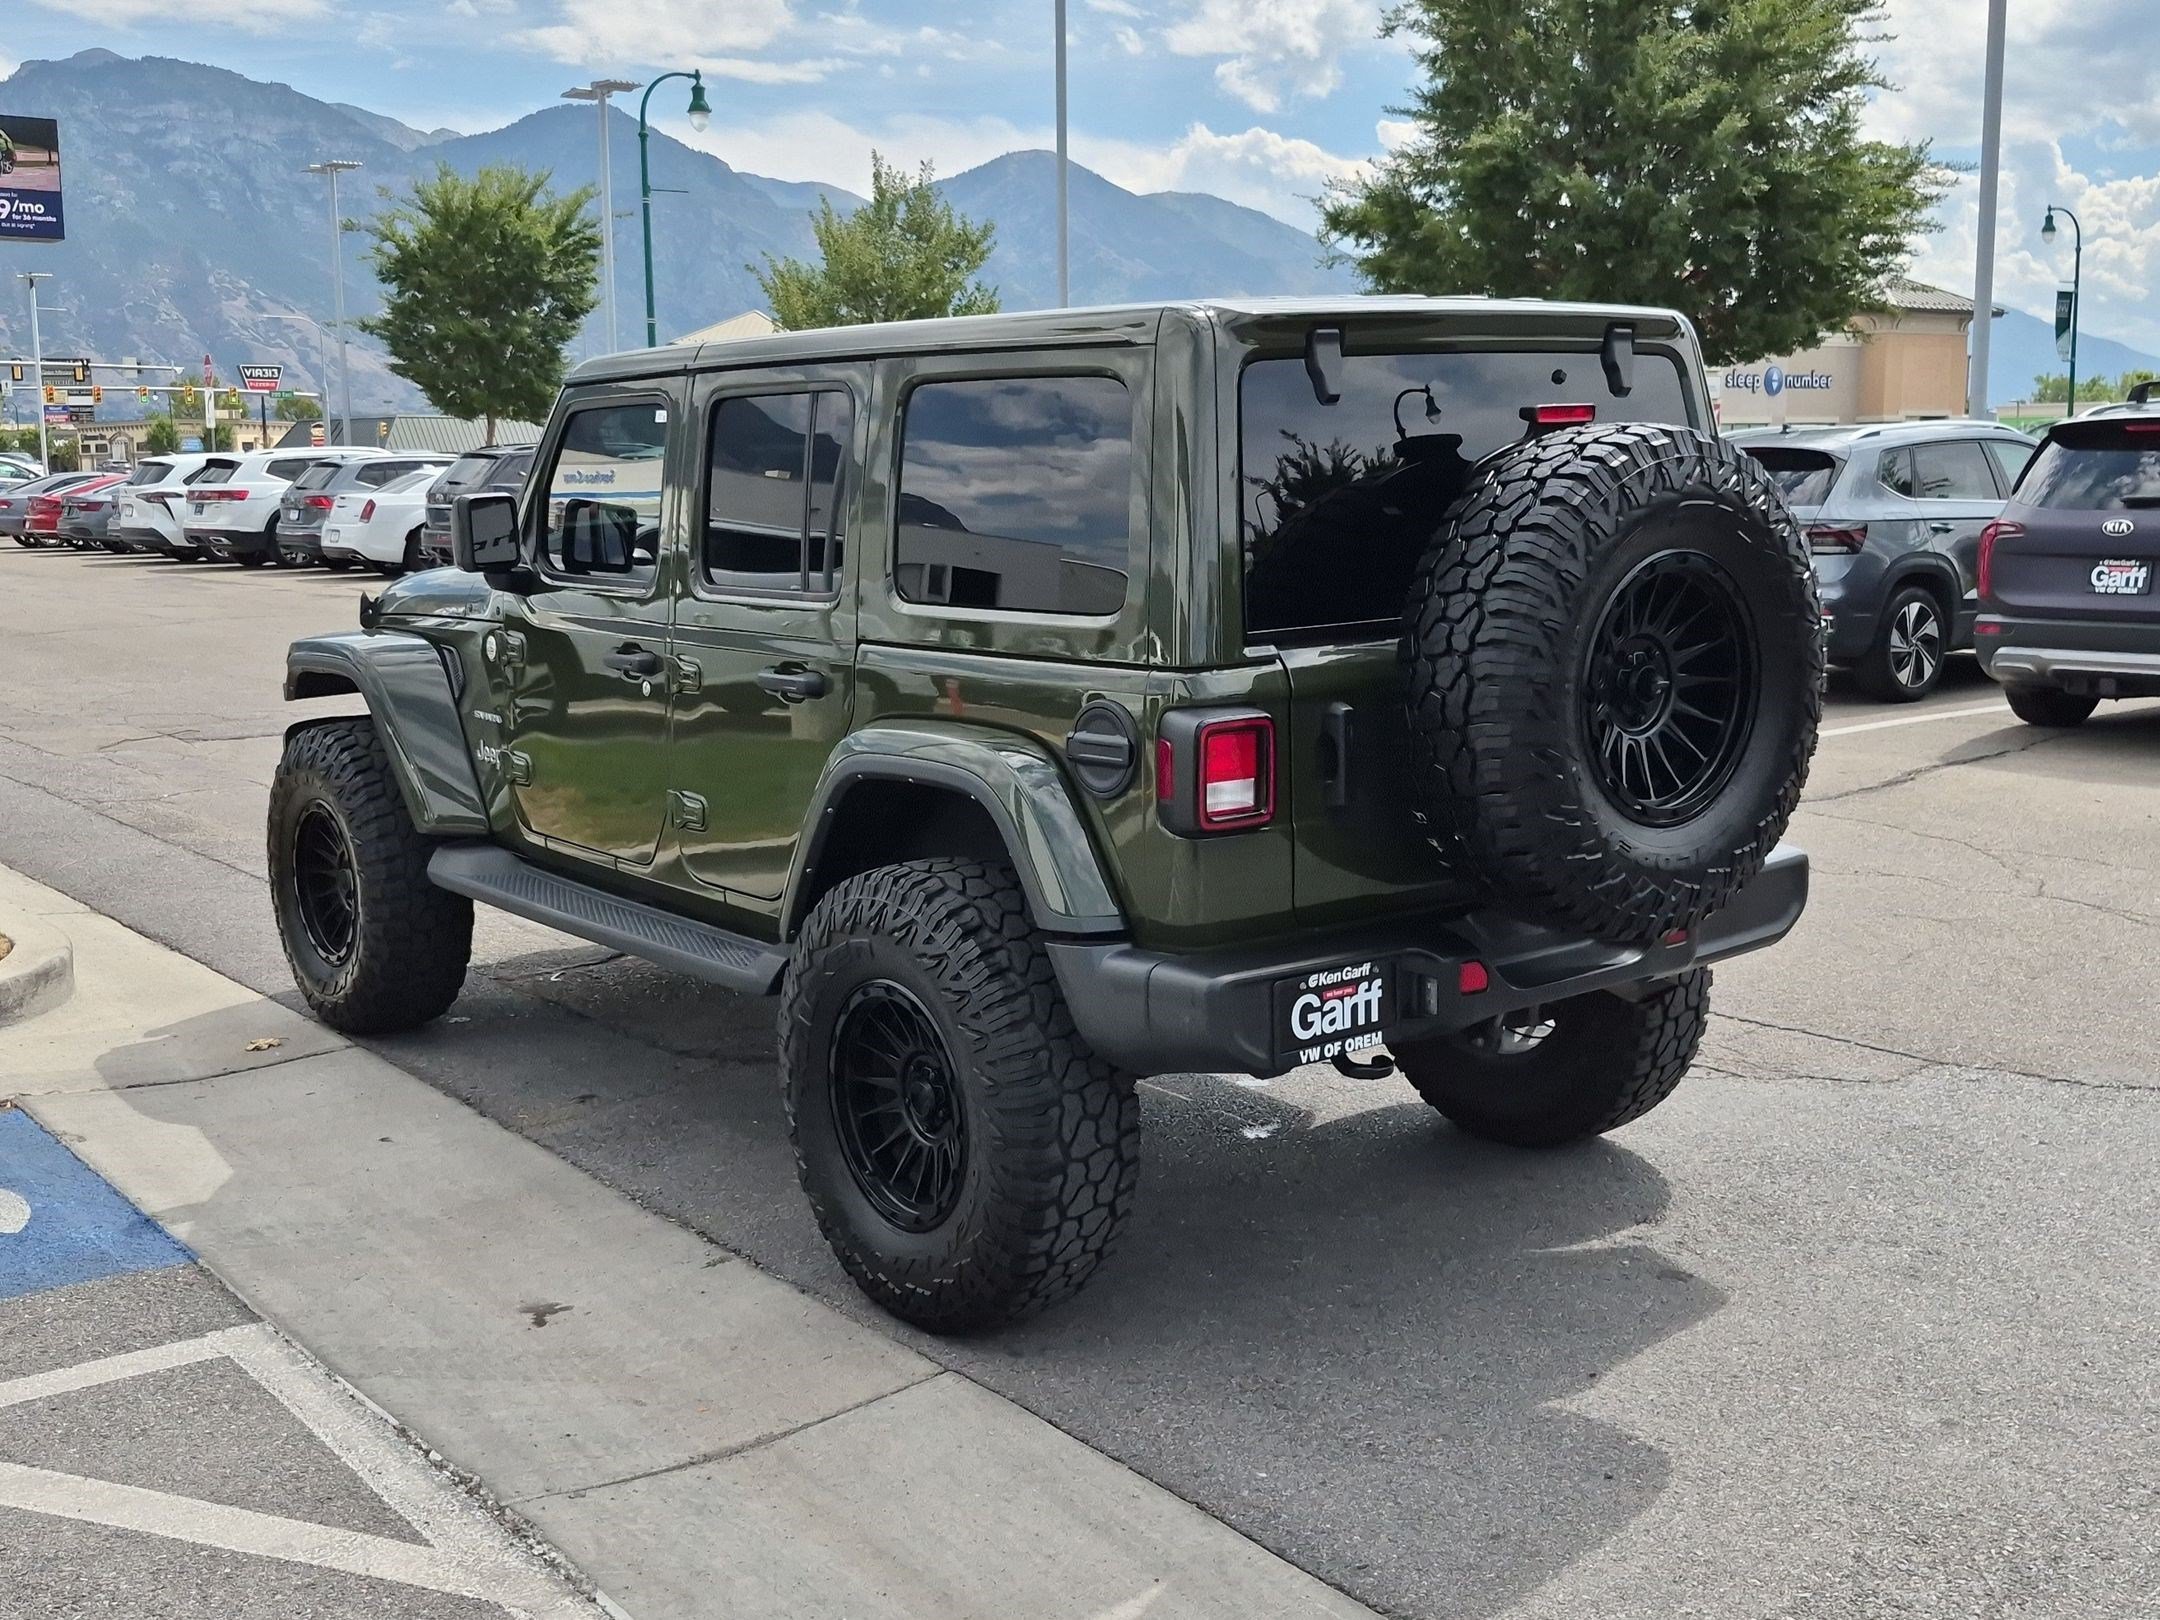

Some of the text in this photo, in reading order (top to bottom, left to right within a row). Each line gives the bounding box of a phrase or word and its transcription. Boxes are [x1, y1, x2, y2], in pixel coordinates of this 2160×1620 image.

[1725, 369, 1833, 393] sleep number
[2106, 522, 2128, 533] KIA
[2091, 565, 2147, 588] Garff
[477, 739, 501, 770] Jeep
[1318, 962, 1372, 987] Ken Garff
[1291, 978, 1383, 1041] Garff
[1299, 1031, 1383, 1064] VW OF OREM
